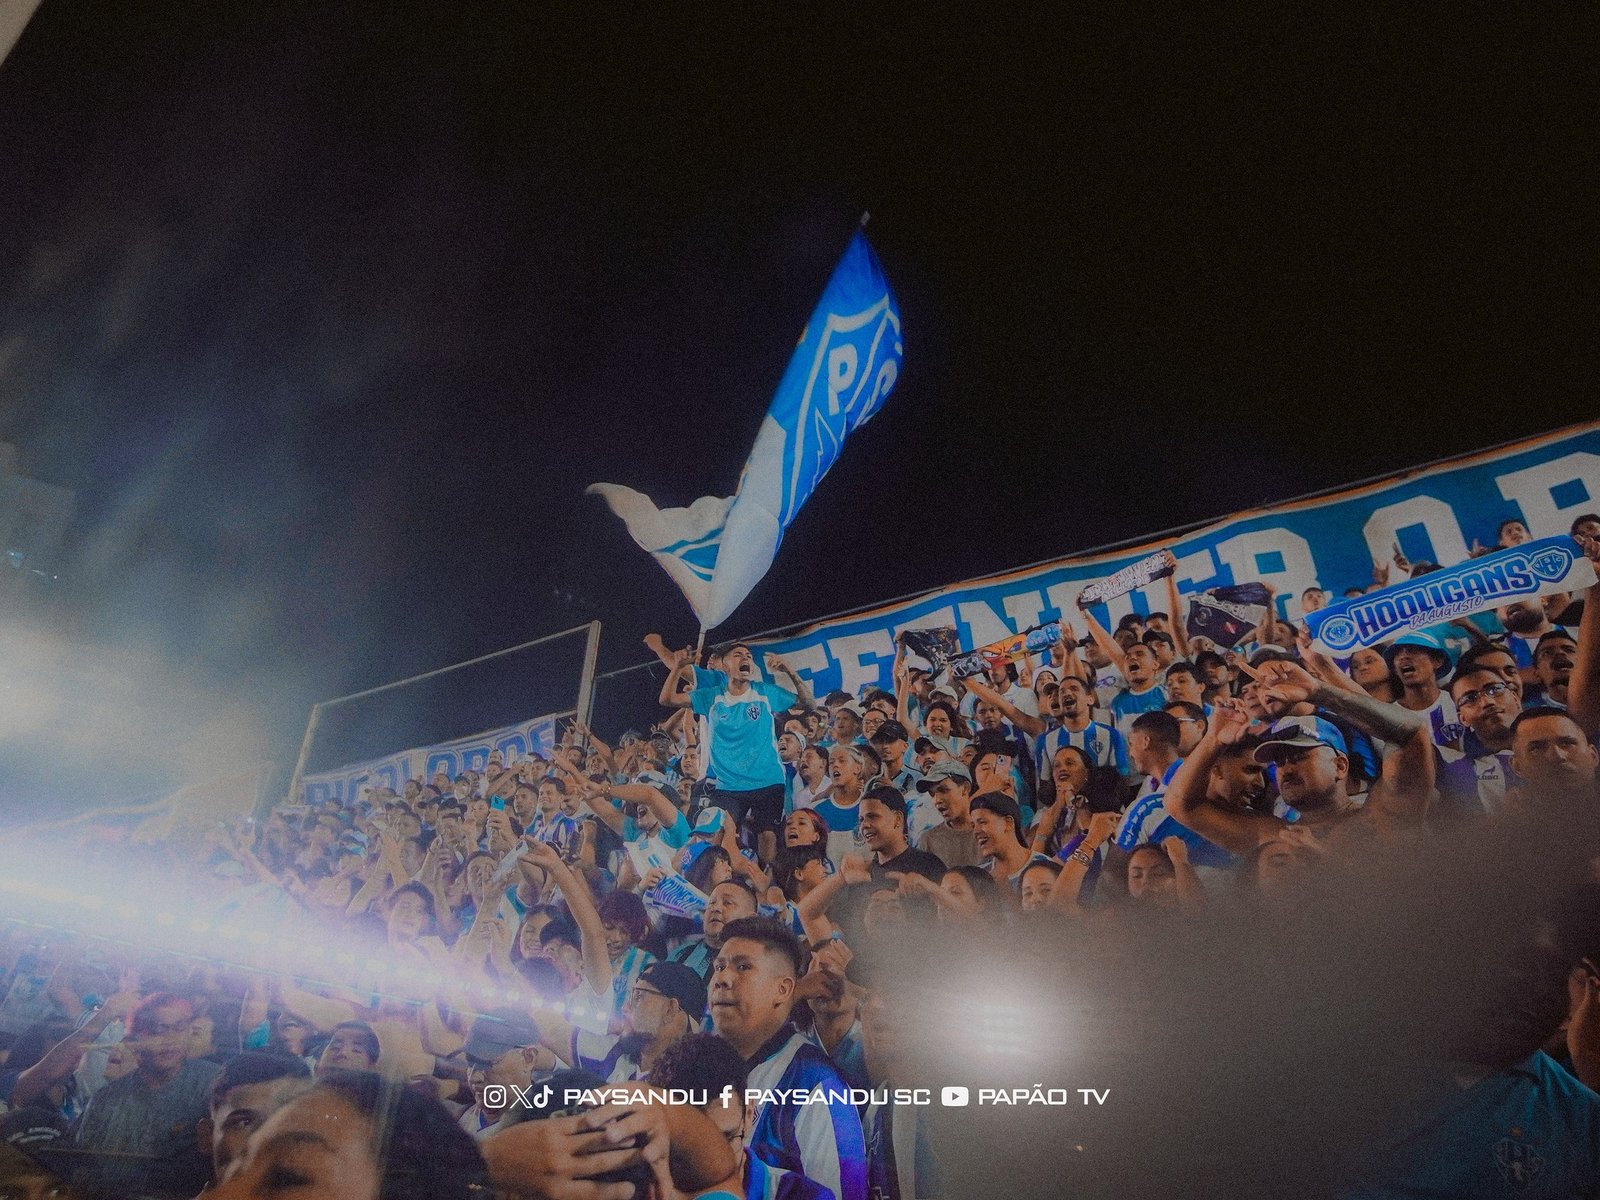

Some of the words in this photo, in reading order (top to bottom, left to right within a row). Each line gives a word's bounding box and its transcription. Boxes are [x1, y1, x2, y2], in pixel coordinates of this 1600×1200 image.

[1352, 557, 1533, 639] HOOLIGANS
[1409, 612, 1426, 628] DA
[1428, 596, 1483, 621] AUGUSTO
